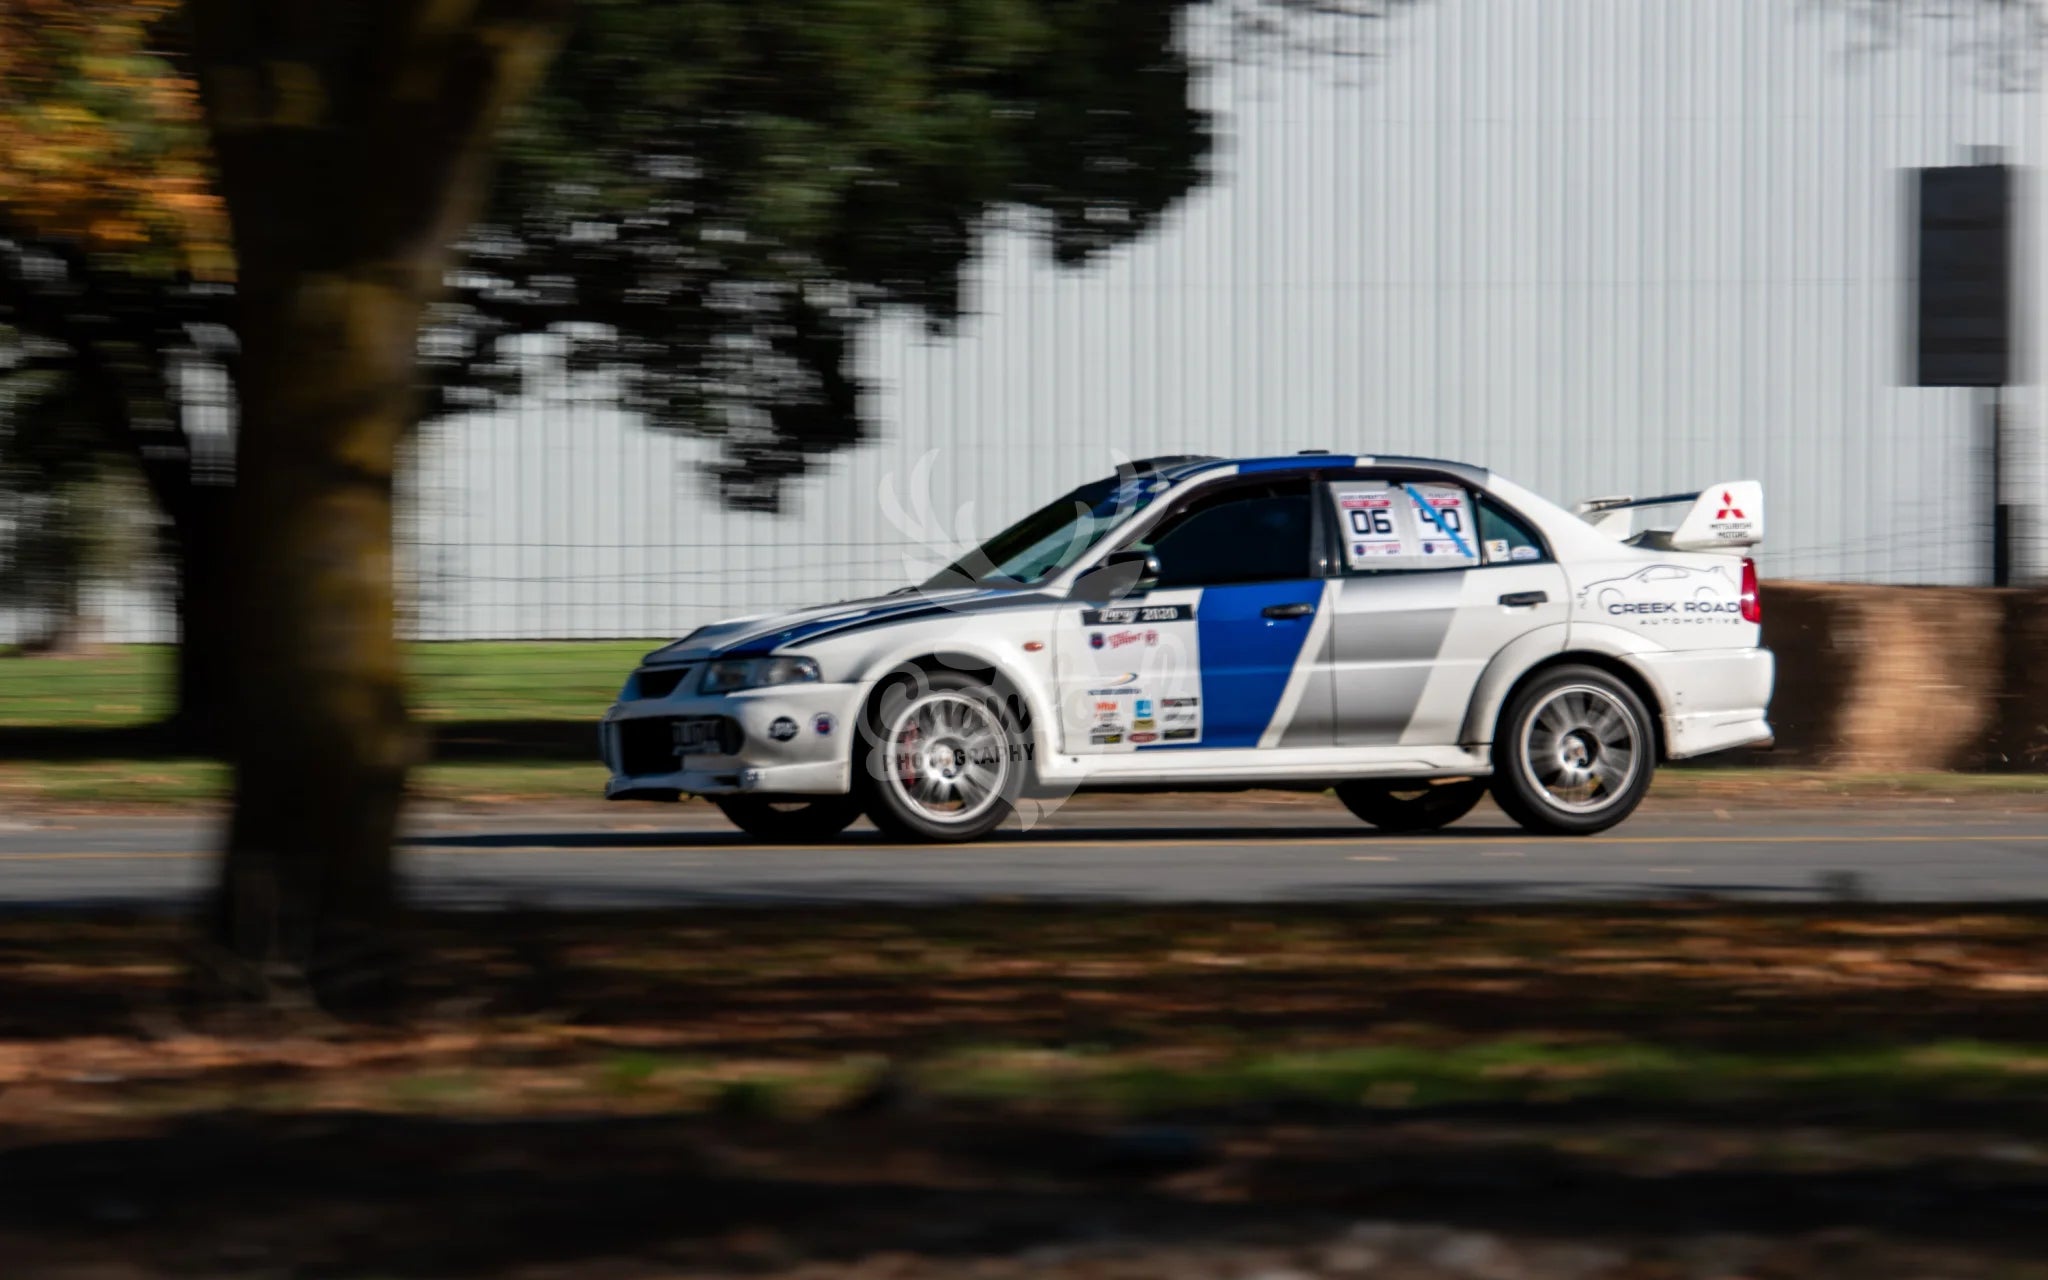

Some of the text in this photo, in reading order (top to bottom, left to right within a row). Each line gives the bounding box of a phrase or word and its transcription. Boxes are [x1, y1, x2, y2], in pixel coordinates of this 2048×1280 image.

[1349, 509, 1393, 534] 06
[1419, 508, 1461, 533] 40
[1608, 601, 1740, 615] CREEK ROAD
